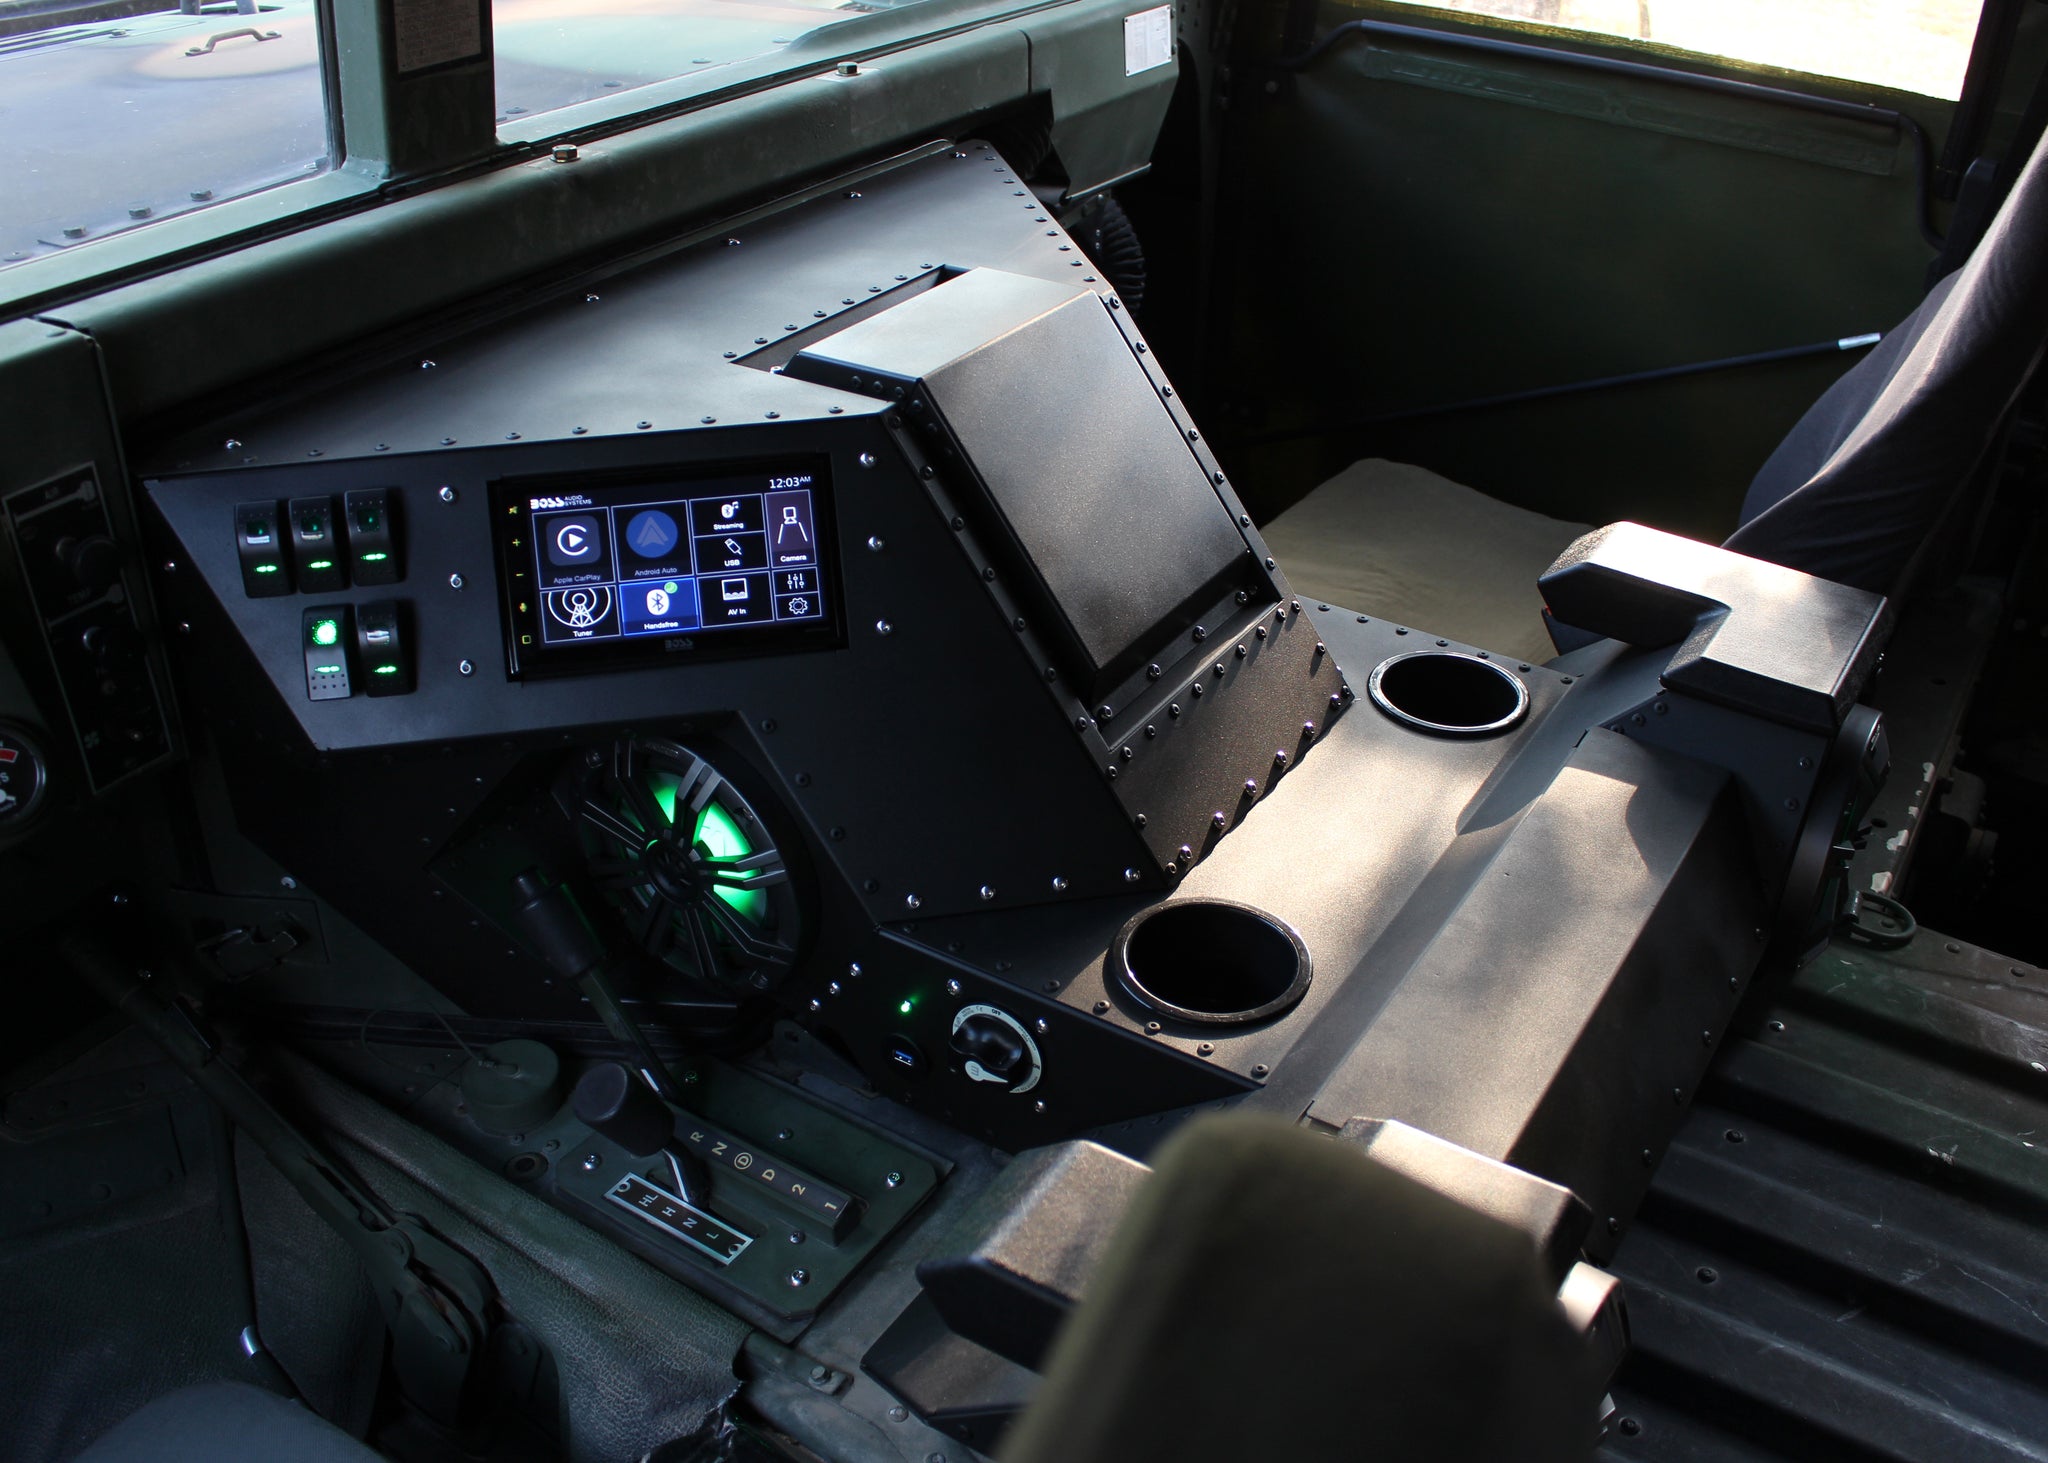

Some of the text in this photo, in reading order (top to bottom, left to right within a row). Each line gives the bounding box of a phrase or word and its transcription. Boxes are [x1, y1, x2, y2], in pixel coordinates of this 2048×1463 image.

[530, 497, 564, 510] BOSS
[564, 499, 592, 507] SYSTEMS
[713, 522, 744, 530] Streaming
[724, 559, 740, 567] USB
[634, 566, 678, 576] Android Auto
[553, 574, 601, 584] Apple CarPlay
[643, 621, 679, 630] Handsfree
[665, 639, 693, 648] BOSS
[690, 1131, 837, 1210] R N D D 2 1
[638, 1194, 720, 1240] HL H N L
